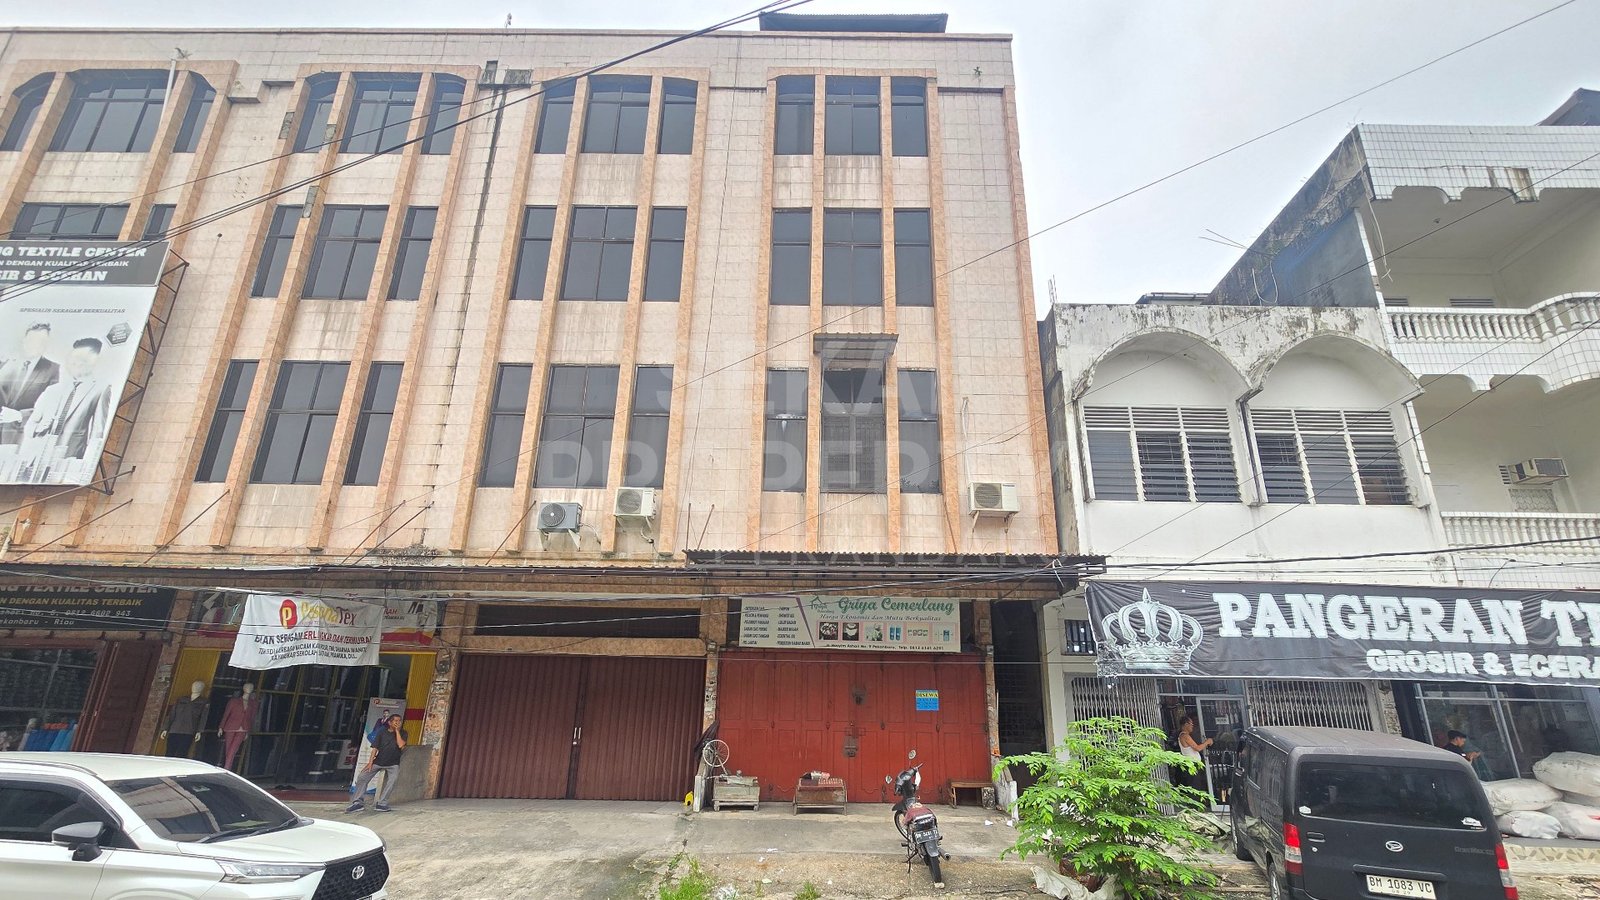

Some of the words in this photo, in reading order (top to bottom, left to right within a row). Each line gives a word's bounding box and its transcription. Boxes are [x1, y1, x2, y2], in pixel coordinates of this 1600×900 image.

[19, 247, 82, 257] TEXTILE
[85, 247, 147, 257] CENTER
[23, 270, 36, 281] &
[27, 585, 91, 593] TEXTILE
[95, 585, 157, 594] CENTER
[10, 598, 49, 606] DENGAN
[52, 598, 98, 606] KUALITAS
[101, 598, 143, 606] TERBAIK
[838, 596, 878, 614] Griya
[881, 597, 955, 616] Cemerlang
[1212, 592, 1529, 645] PANGERAN
[1366, 649, 1479, 675] GROSIR
[1482, 652, 1507, 676] &
[1369, 876, 1383, 887] BM
[1387, 878, 1414, 890] 1083
[1417, 881, 1432, 893] VC
